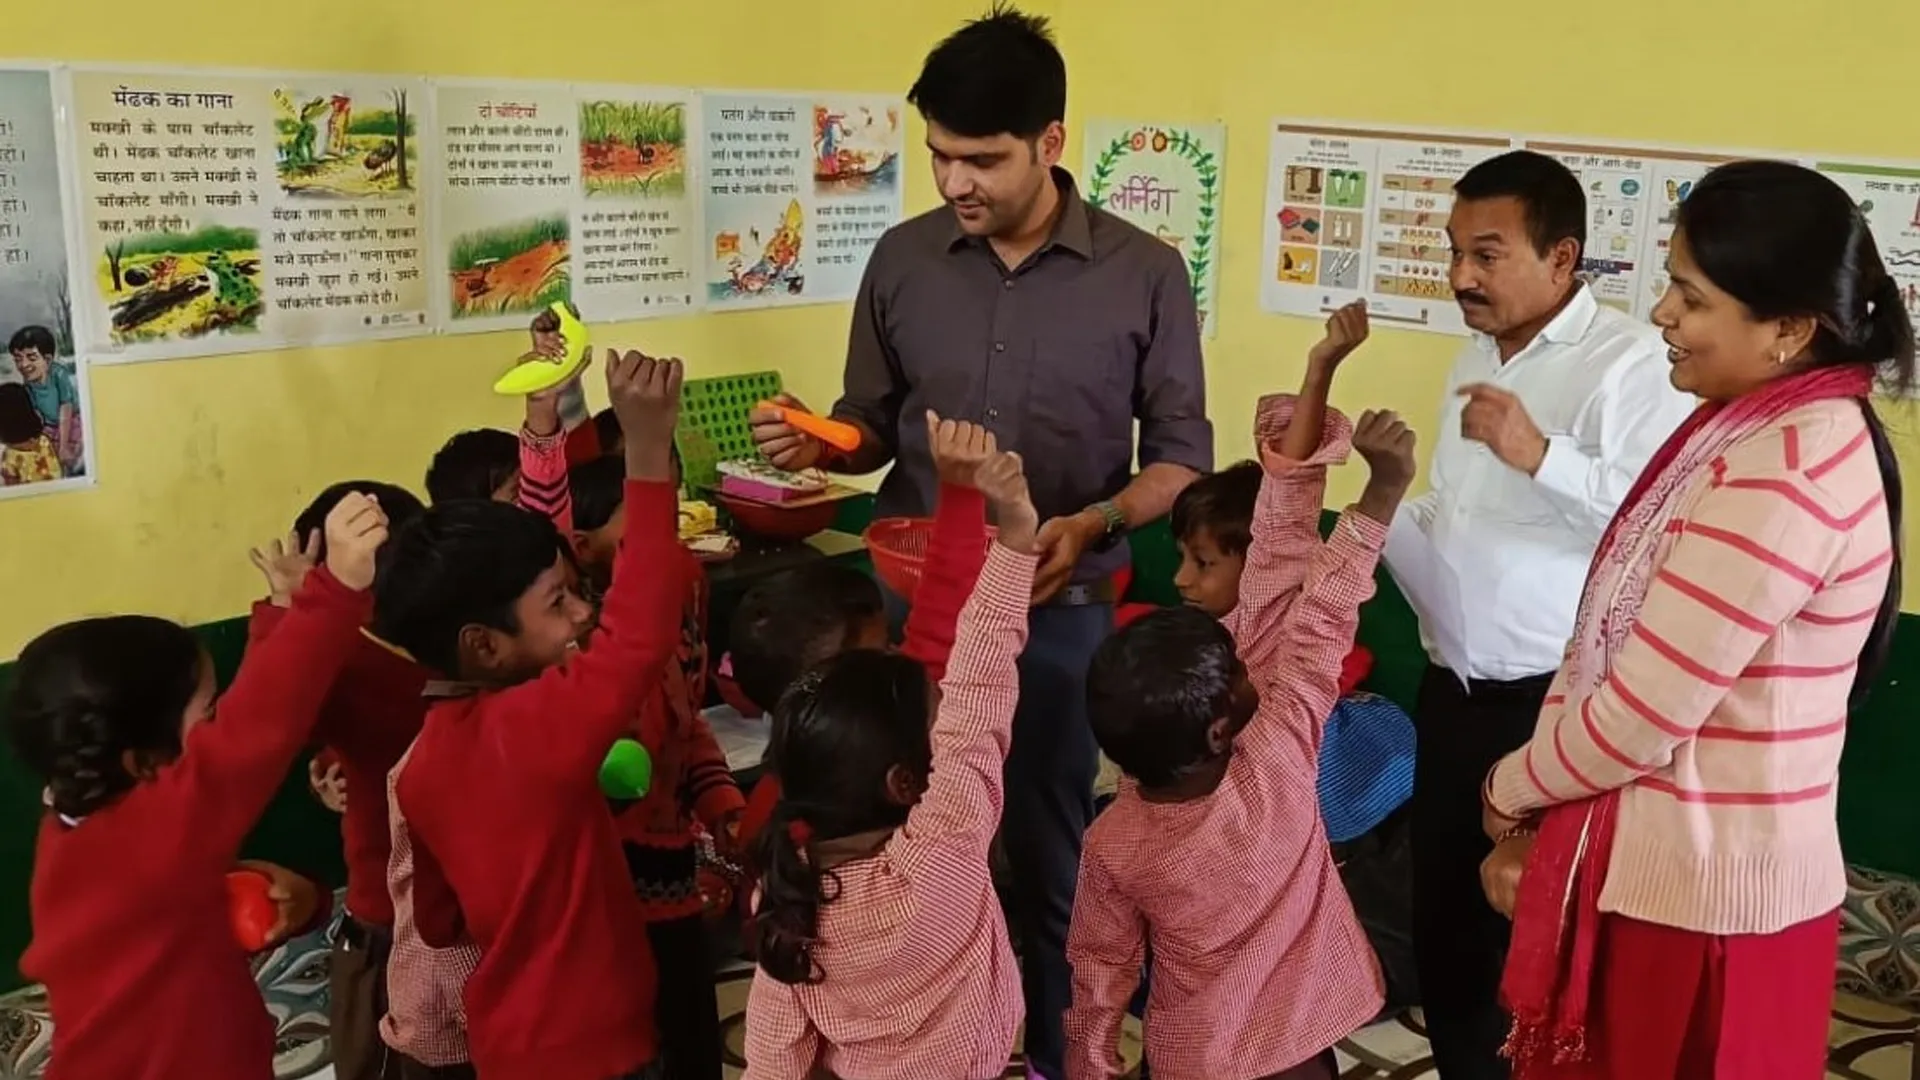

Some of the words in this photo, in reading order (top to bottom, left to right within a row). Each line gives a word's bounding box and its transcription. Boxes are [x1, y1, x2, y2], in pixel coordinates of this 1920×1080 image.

[112, 85, 161, 108] मेंढक
[165, 92, 190, 108] का
[196, 93, 233, 109] गाना
[478, 101, 492, 118] दो
[89, 119, 131, 135] मक्खी
[141, 118, 157, 135] के
[167, 123, 192, 135] पास
[223, 147, 256, 160] खाना
[94, 170, 134, 183] चाहता
[171, 167, 199, 183] उसने
[205, 167, 241, 183] मक्खी
[246, 167, 257, 183] से
[95, 191, 151, 208] चॉकलेट
[204, 190, 241, 206] मक्खी
[249, 190, 259, 206] ने
